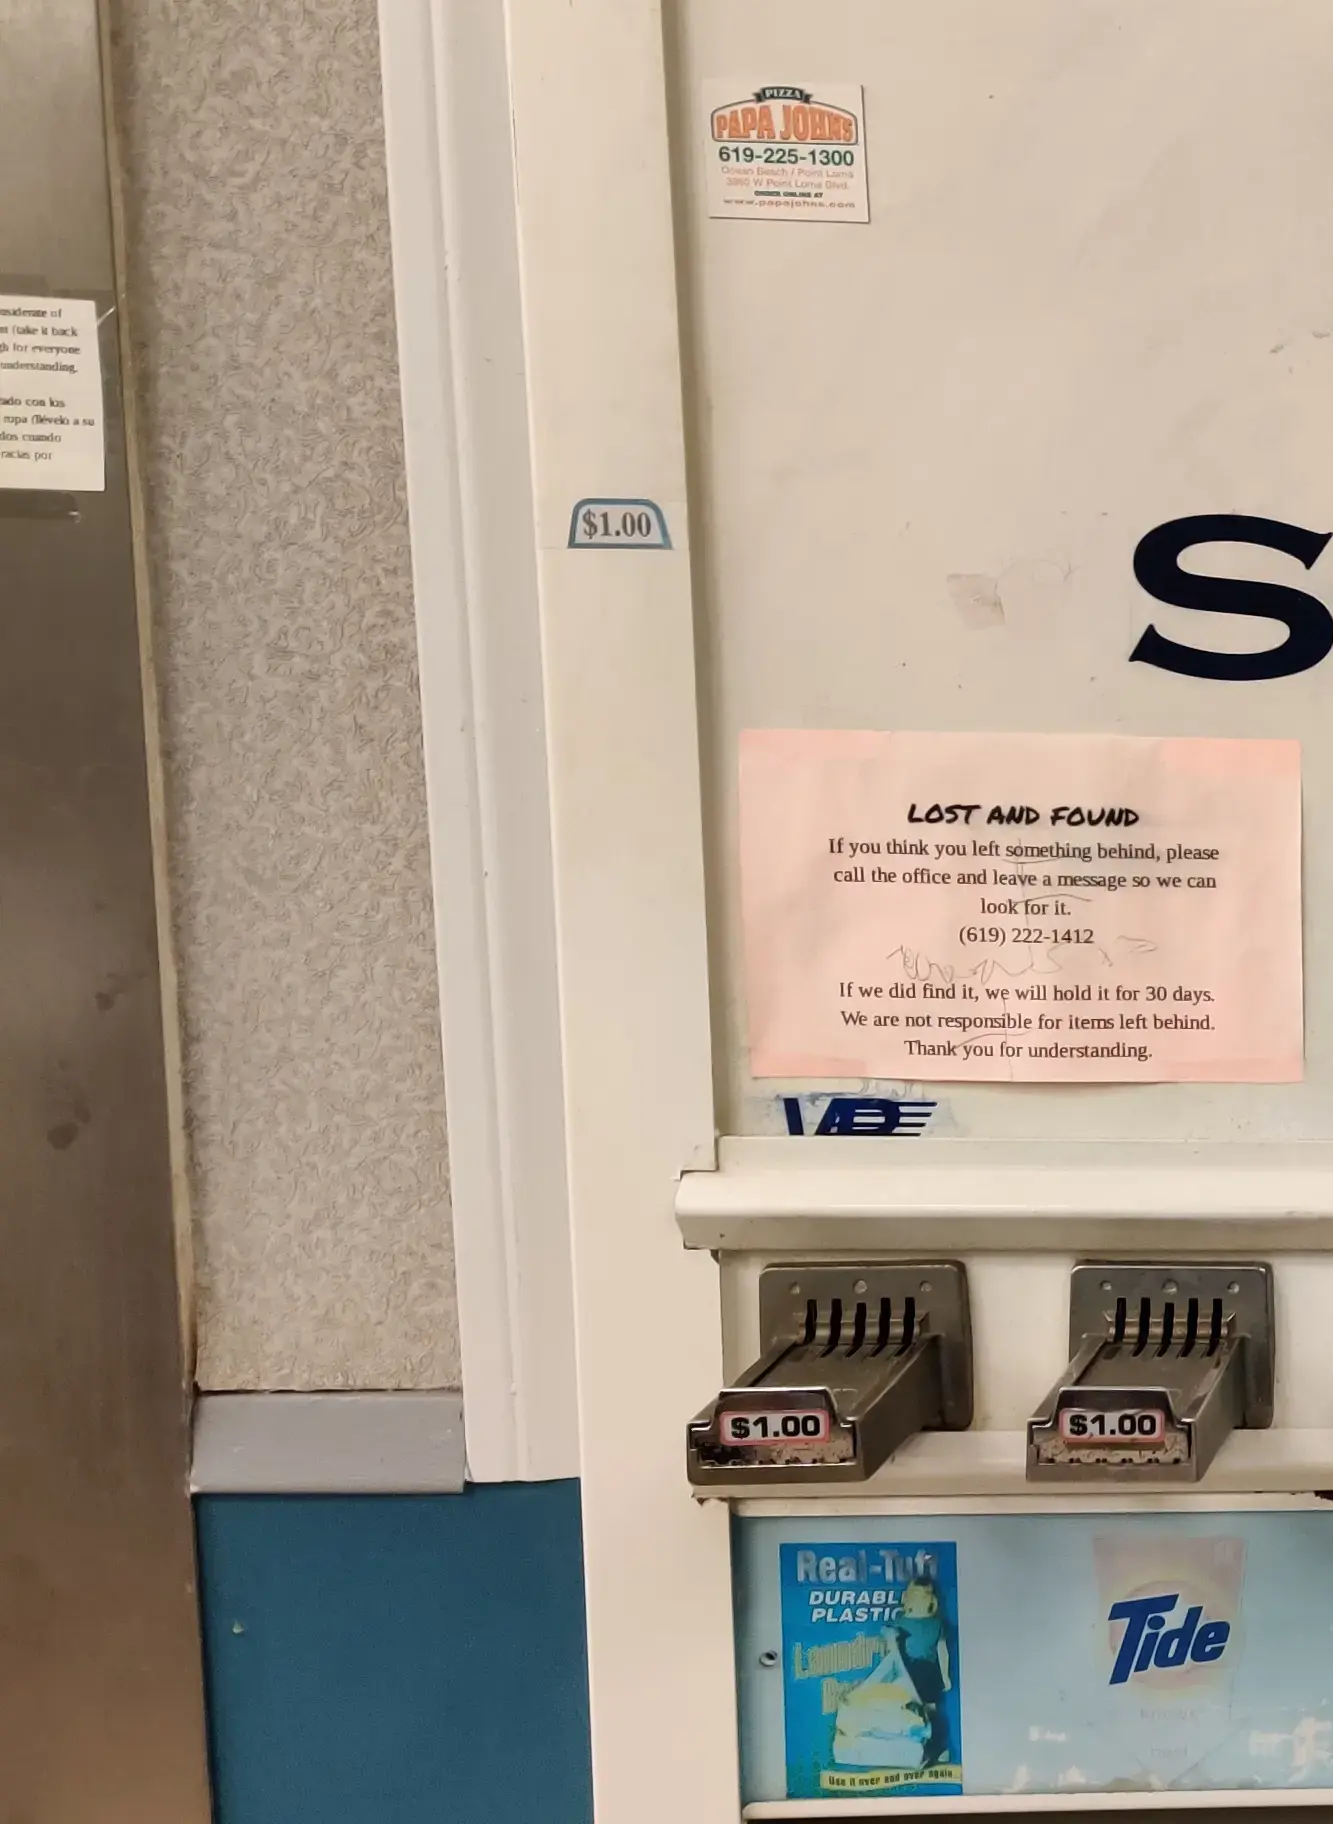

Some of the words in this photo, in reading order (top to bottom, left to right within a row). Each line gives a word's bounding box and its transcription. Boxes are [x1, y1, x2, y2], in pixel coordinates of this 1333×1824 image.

[765, 88, 801, 99] PIZZA
[716, 106, 776, 140] PAPA
[718, 146, 855, 166] 619-225-1300
[582, 508, 651, 540] $1.00
[907, 803, 982, 825] LOST
[986, 805, 1040, 826] AND
[1050, 806, 1140, 828] FOUND
[829, 838, 843, 854] If
[849, 842, 881, 858] you
[886, 838, 929, 856] think
[935, 844, 967, 860] you
[972, 840, 1000, 857] left
[1005, 841, 1092, 862] something
[1097, 843, 1161, 862] behind,
[1166, 844, 1220, 864] please
[833, 867, 865, 883] call
[871, 867, 897, 883] the
[902, 868, 951, 884] office
[956, 869, 987, 885] and
[993, 869, 1037, 886] leave
[1042, 875, 1052, 886] a
[1057, 875, 1127, 891] message
[1132, 876, 1150, 888] so
[1156, 876, 1182, 888] we
[1187, 876, 1217, 889] can
[980, 898, 1018, 915] look
[1024, 899, 1049, 916] for
[1054, 900, 1072, 917] it.
[958, 926, 1006, 947] (619)
[1011, 928, 1094, 945] 222-1412
[839, 982, 853, 998] If
[858, 986, 883, 998] we
[888, 983, 916, 999] did
[922, 983, 956, 1000] find
[961, 984, 980, 1003] it,
[985, 987, 1010, 1000] we
[1015, 984, 1047, 1001] will
[1053, 984, 1092, 1002] hold
[1097, 986, 1110, 1002] it
[1115, 985, 1140, 1002] for
[1145, 986, 1167, 1002] 30
[1172, 986, 1215, 1006] days.
[840, 1011, 868, 1027] We
[873, 1015, 900, 1028] are
[904, 1013, 932, 1028] not
[937, 1012, 1032, 1033] responsible
[1038, 1013, 1062, 1030] for
[1068, 1014, 1115, 1030] items
[1119, 1014, 1148, 1031] left
[1152, 1014, 1216, 1031] behind.
[904, 1040, 957, 1057] Thank
[963, 1044, 994, 1062] you
[999, 1041, 1023, 1058] for
[1028, 1042, 1153, 1062] understanding.
[730, 1413, 821, 1440] $1.00
[1068, 1413, 1158, 1437] $1.00
[809, 1590, 906, 1606] DURABL
[1108, 1593, 1231, 1686] Tide
[884, 1773, 900, 1784] and
[903, 1770, 924, 1782] over
